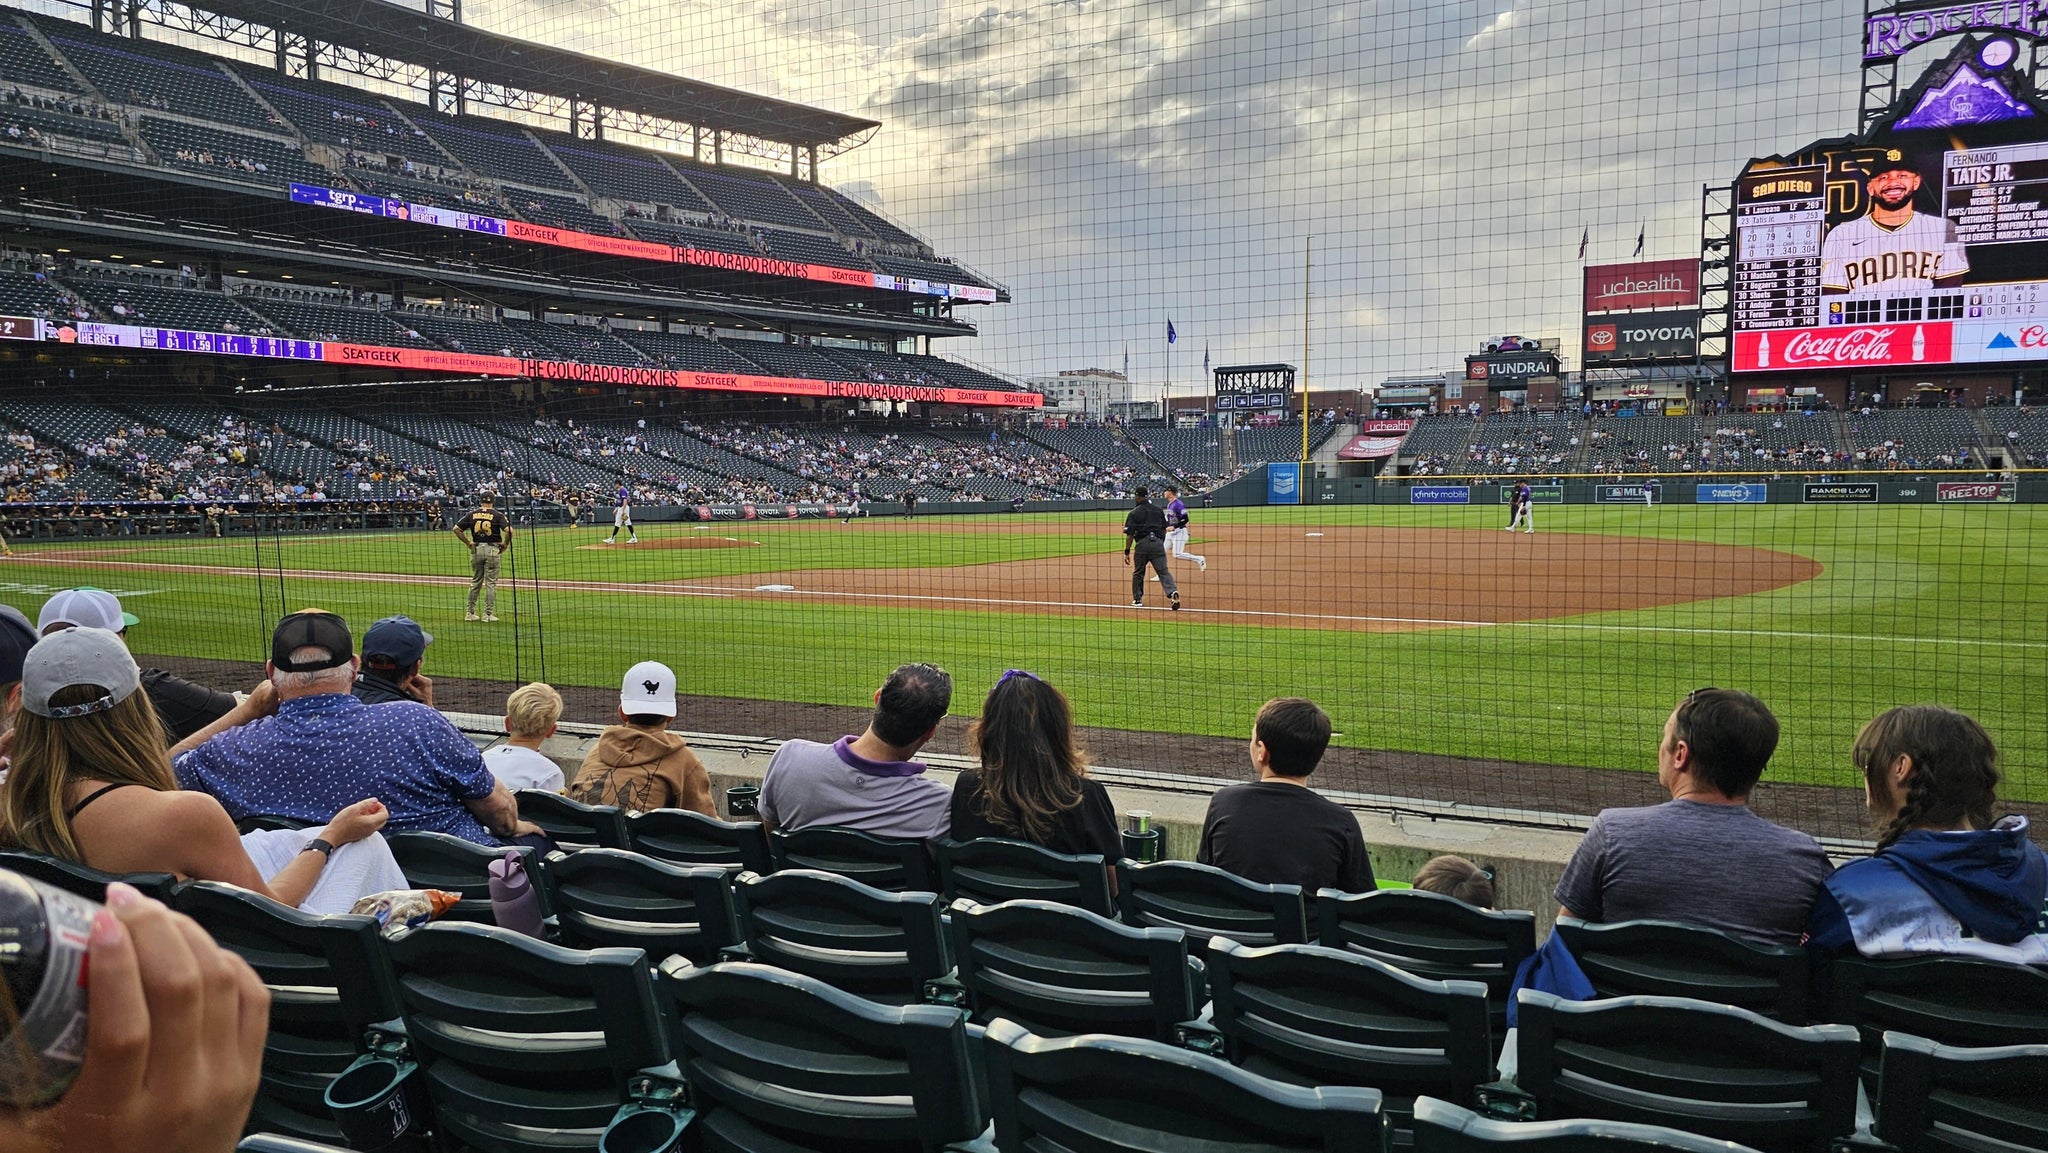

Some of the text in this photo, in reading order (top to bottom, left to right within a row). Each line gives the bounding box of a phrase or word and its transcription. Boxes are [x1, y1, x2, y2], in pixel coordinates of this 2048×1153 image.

[1863, 0, 2048, 59] ROCKIE
[1953, 152, 1997, 165] FERNANDO
[1951, 164, 2014, 184] TATIS JR.
[1753, 181, 1812, 198] SAN DIEGO
[1972, 188, 1996, 196] HEIGHT:
[329, 190, 356, 205] tgrp
[1970, 197, 1996, 205] WEIGHT:
[1997, 213, 2023, 222] JANUARY
[1996, 230, 2020, 239] MARCH
[514, 224, 559, 242] SEATGEEK
[588, 240, 608, 248] OFFICIAL
[610, 242, 626, 250] TICKET
[670, 246, 692, 263] THE
[694, 251, 759, 272] COLORADO
[762, 259, 808, 278] ROCKIES
[832, 271, 866, 284] SEATGEEK
[1845, 251, 1945, 290] PADRES
[1603, 273, 1682, 296] uchealth
[1750, 282, 1777, 290] Bogaerts
[1973, 296, 1978, 304] 0
[2031, 293, 2035, 301] 2
[2030, 305, 2035, 313] 2
[80, 324, 105, 333] JIMMY
[1623, 326, 1695, 342] TOYOTA
[80, 333, 117, 344] HERGET
[167, 338, 179, 348] 0-1
[192, 340, 211, 351] 1.59
[221, 342, 238, 352] 11.1
[252, 344, 257, 354] 2
[270, 346, 275, 356] 0
[1784, 328, 1897, 363] Coca-Cola
[289, 347, 295, 357] 2
[310, 348, 315, 358] 9
[1489, 362, 1545, 374] TUNDRA
[343, 347, 401, 363] SEATGEEK
[423, 356, 448, 365] OFFICIAL
[470, 360, 508, 369] MARKETPLACE
[520, 359, 543, 377] THE
[547, 362, 619, 382] COLORADO
[622, 368, 678, 386] ROCKIES
[695, 375, 737, 387] SEATGEEK
[825, 381, 844, 396] THE
[846, 383, 903, 399] COLORADO
[905, 386, 945, 401] ROCKIES
[957, 392, 987, 401] SEATGEEK
[1004, 394, 1035, 404] SEATGEEK
[1370, 420, 1409, 431] uchealth
[1414, 489, 1468, 499] xfinity mobile
